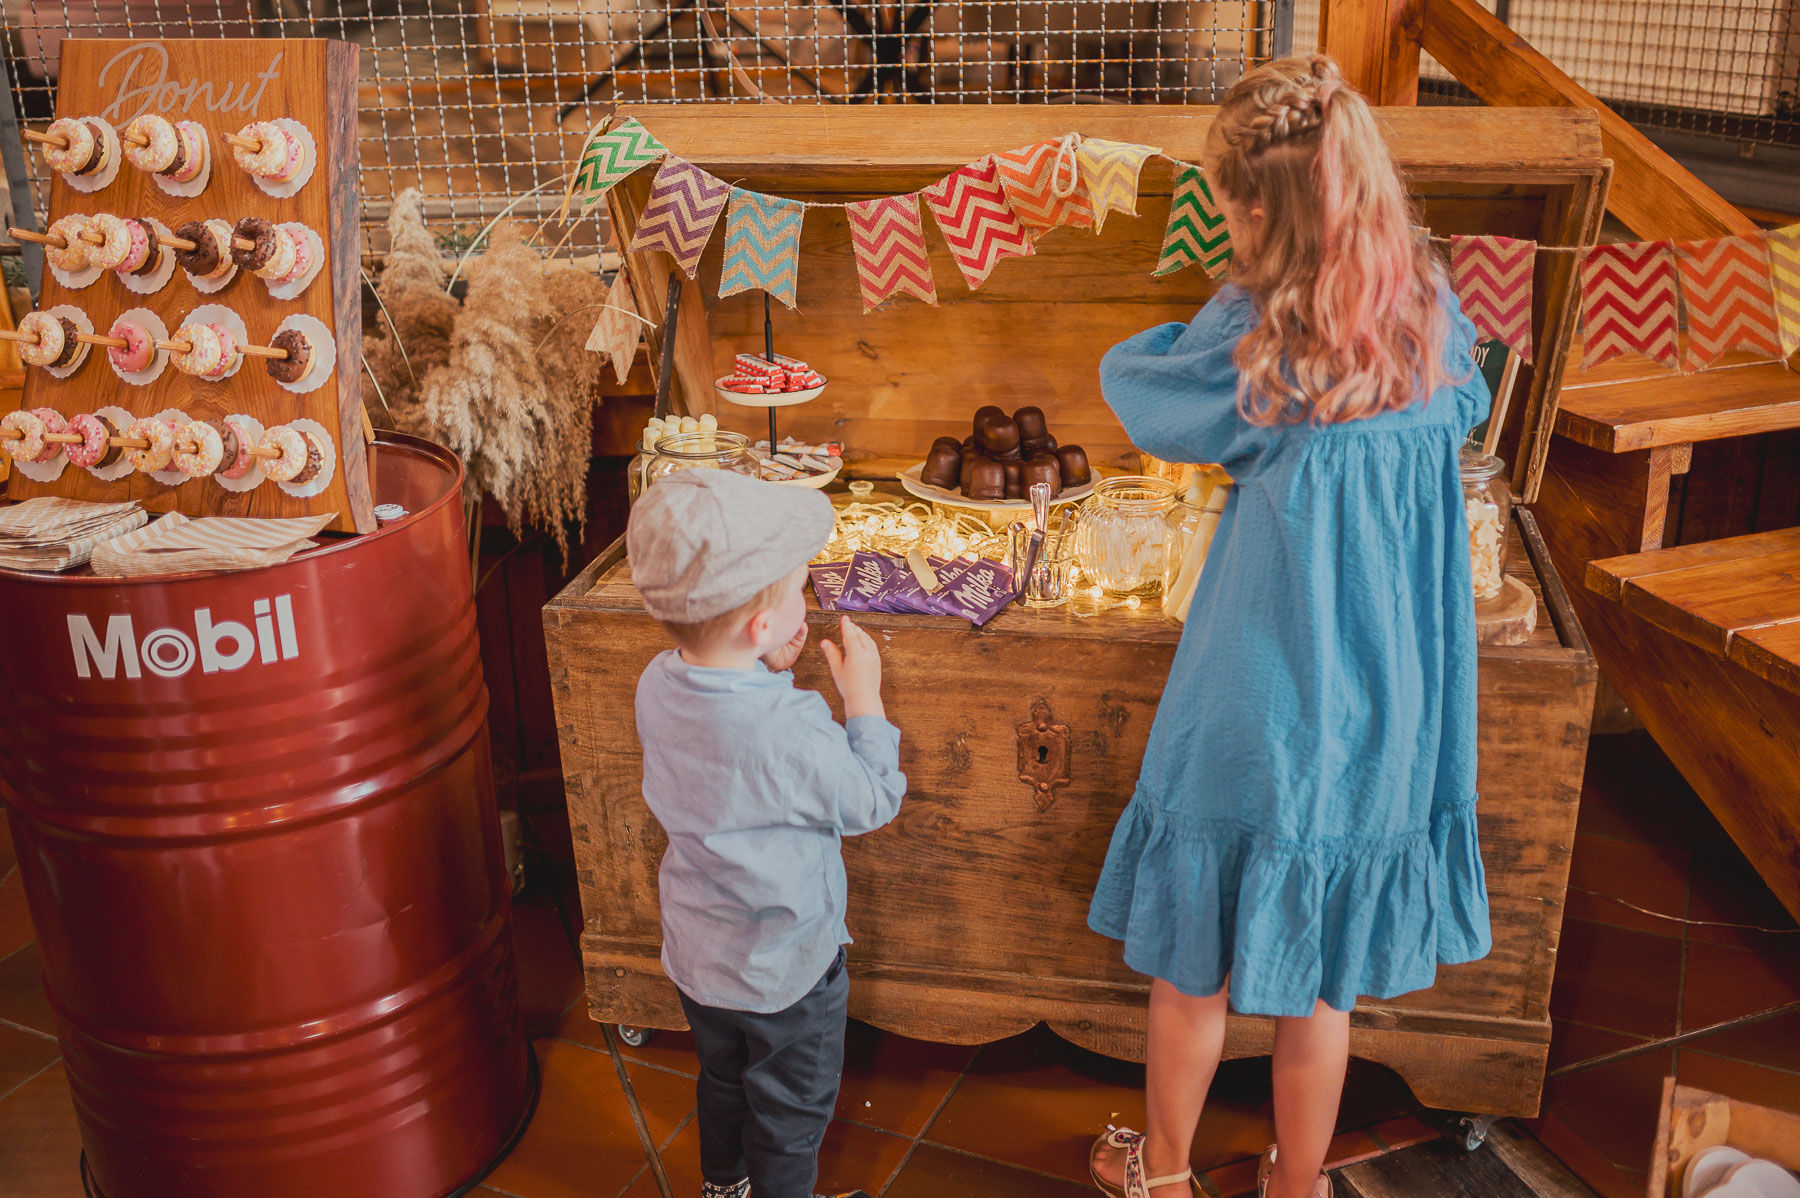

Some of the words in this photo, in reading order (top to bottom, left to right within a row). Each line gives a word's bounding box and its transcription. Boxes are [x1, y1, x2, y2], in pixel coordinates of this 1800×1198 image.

[98, 42, 283, 130] Donut
[953, 568, 995, 610] Milka
[67, 594, 299, 679] Mobil
